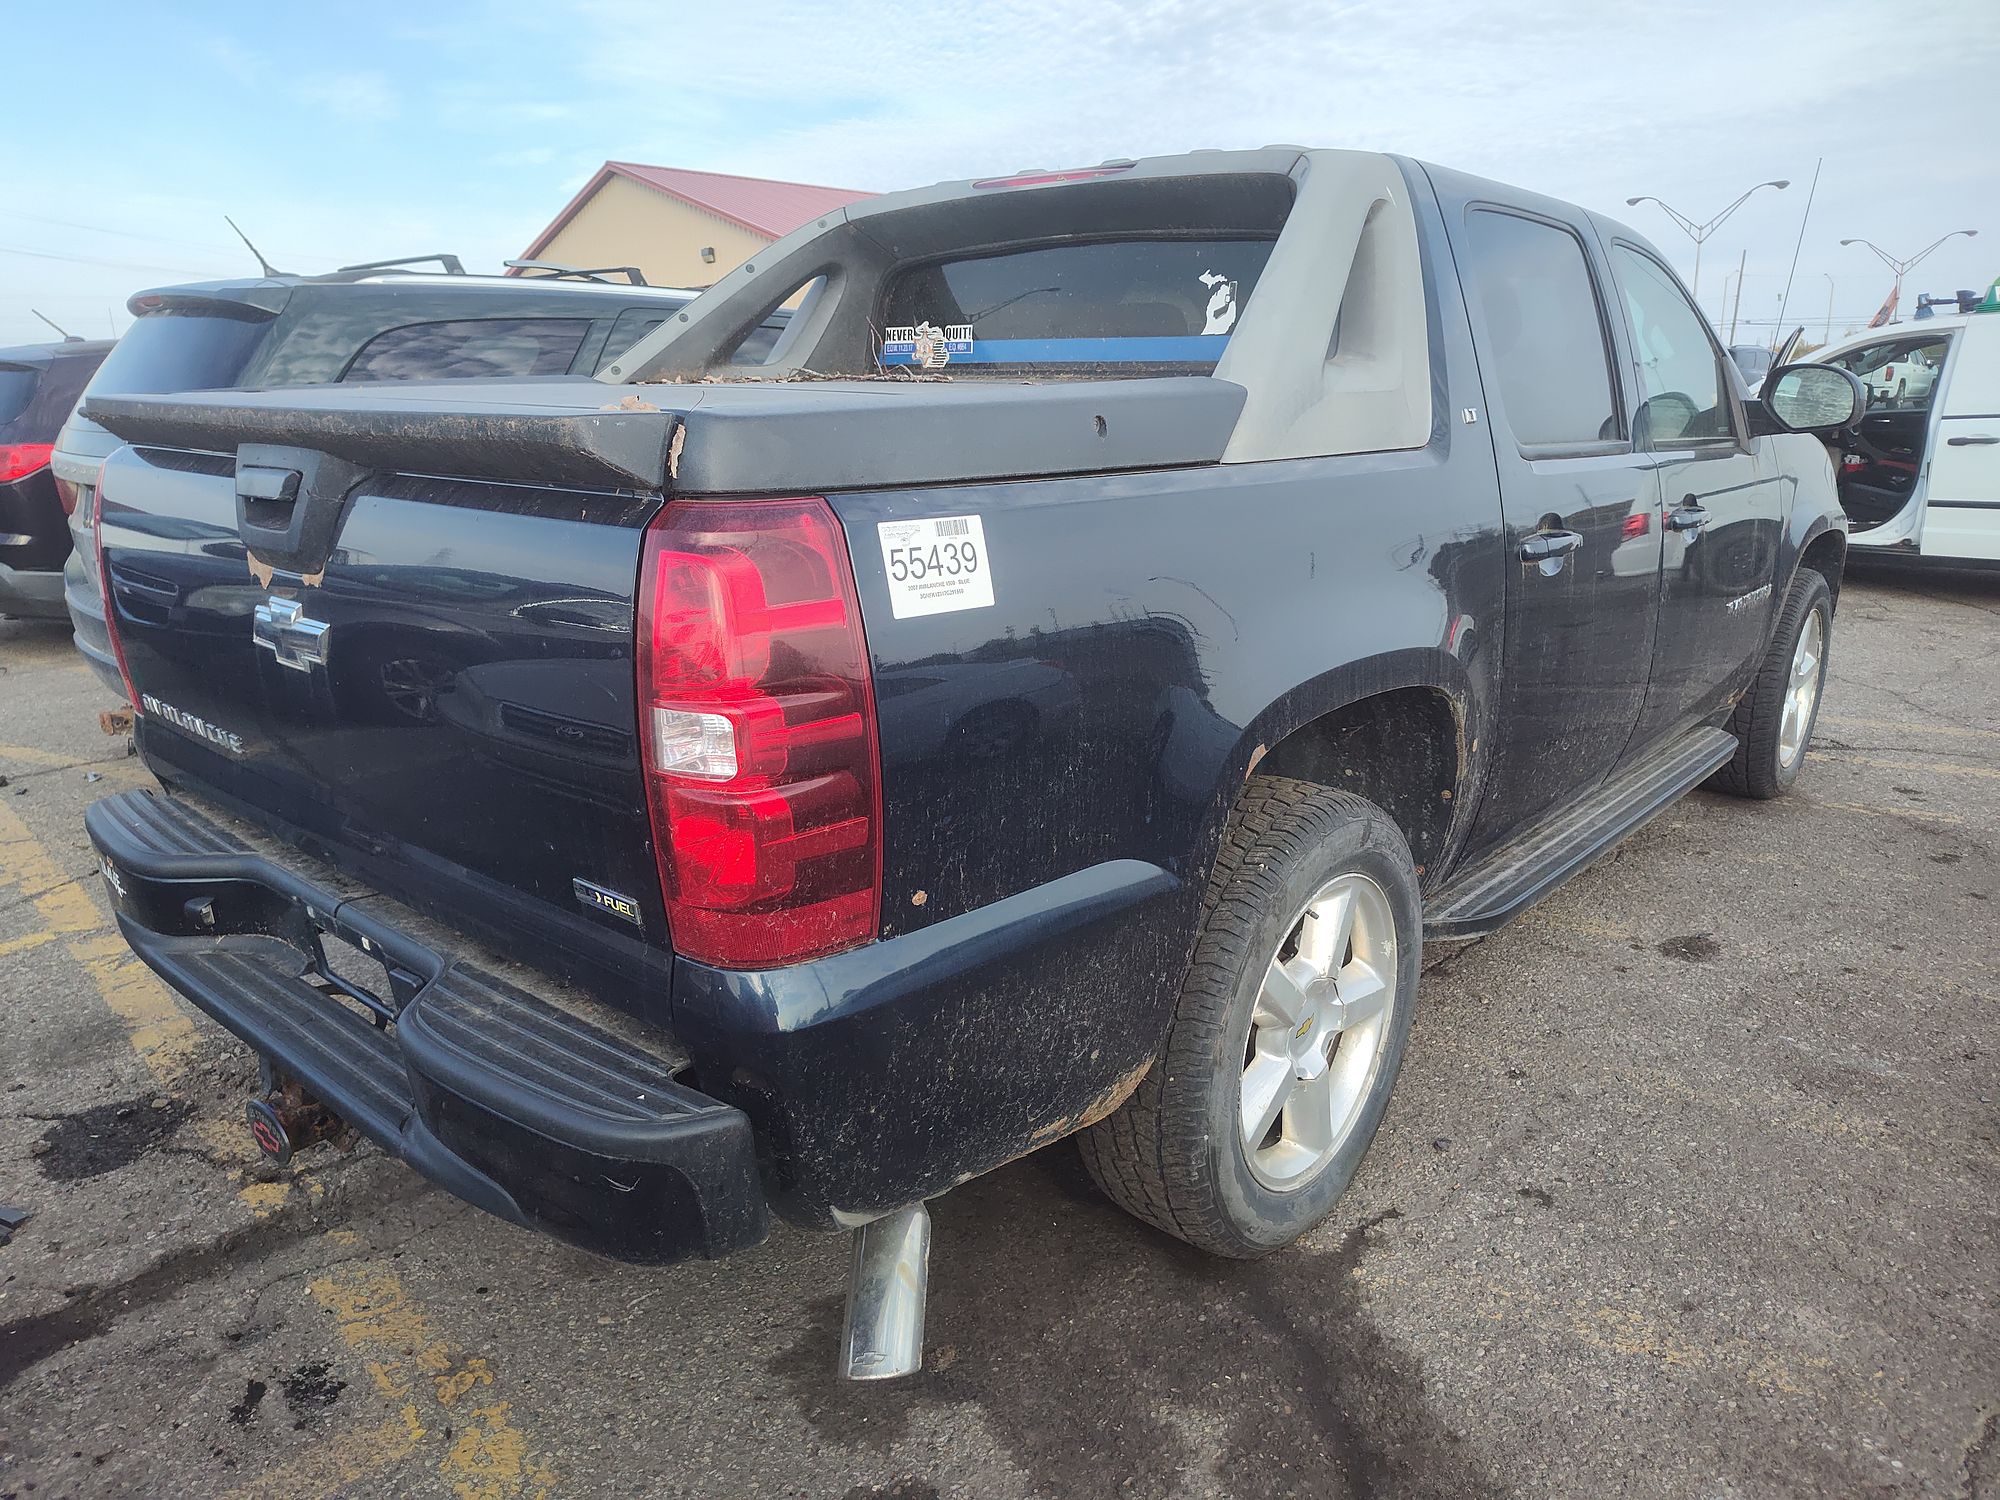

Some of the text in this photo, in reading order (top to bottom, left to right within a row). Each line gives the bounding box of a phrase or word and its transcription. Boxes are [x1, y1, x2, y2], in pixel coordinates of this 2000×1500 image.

[886, 326, 971, 342] NEVER QUIT!
[1462, 408, 1477, 424] LT
[890, 541, 978, 582] 55439
[603, 895, 635, 918] FUEL
